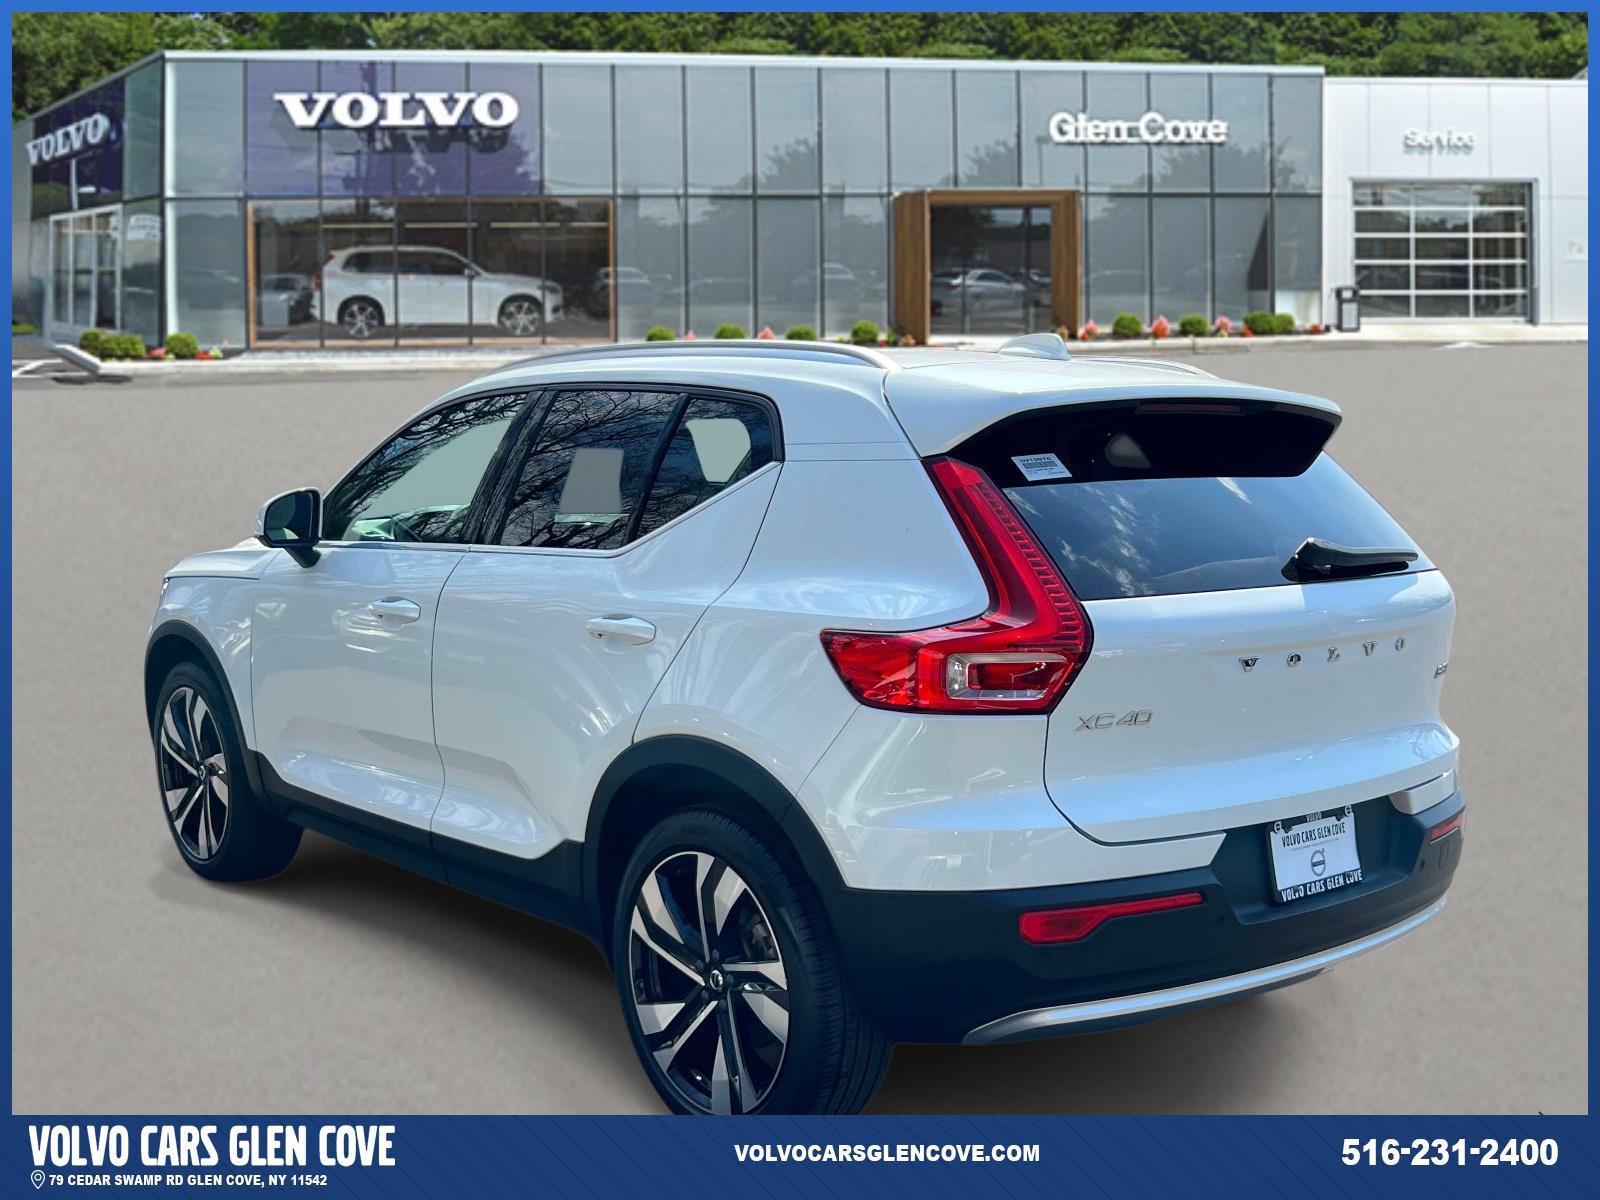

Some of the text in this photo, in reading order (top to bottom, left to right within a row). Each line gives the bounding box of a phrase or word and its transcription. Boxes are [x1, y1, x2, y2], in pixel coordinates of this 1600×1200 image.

[274, 91, 519, 127] VOLVO
[25, 113, 110, 165] VOLVO
[1049, 111, 1228, 144] Glen Cove
[1403, 128, 1476, 149] Service
[1239, 637, 1406, 672] VOLVO
[1075, 709, 1152, 732] XC40
[1281, 833, 1301, 848] VOLVO
[1301, 829, 1317, 844] CARS
[1317, 825, 1331, 840] GLEN
[1331, 822, 1346, 836] COVE
[1281, 885, 1305, 902] VOLVO
[1306, 880, 1325, 895] CARS
[1326, 875, 1344, 890] GLEN
